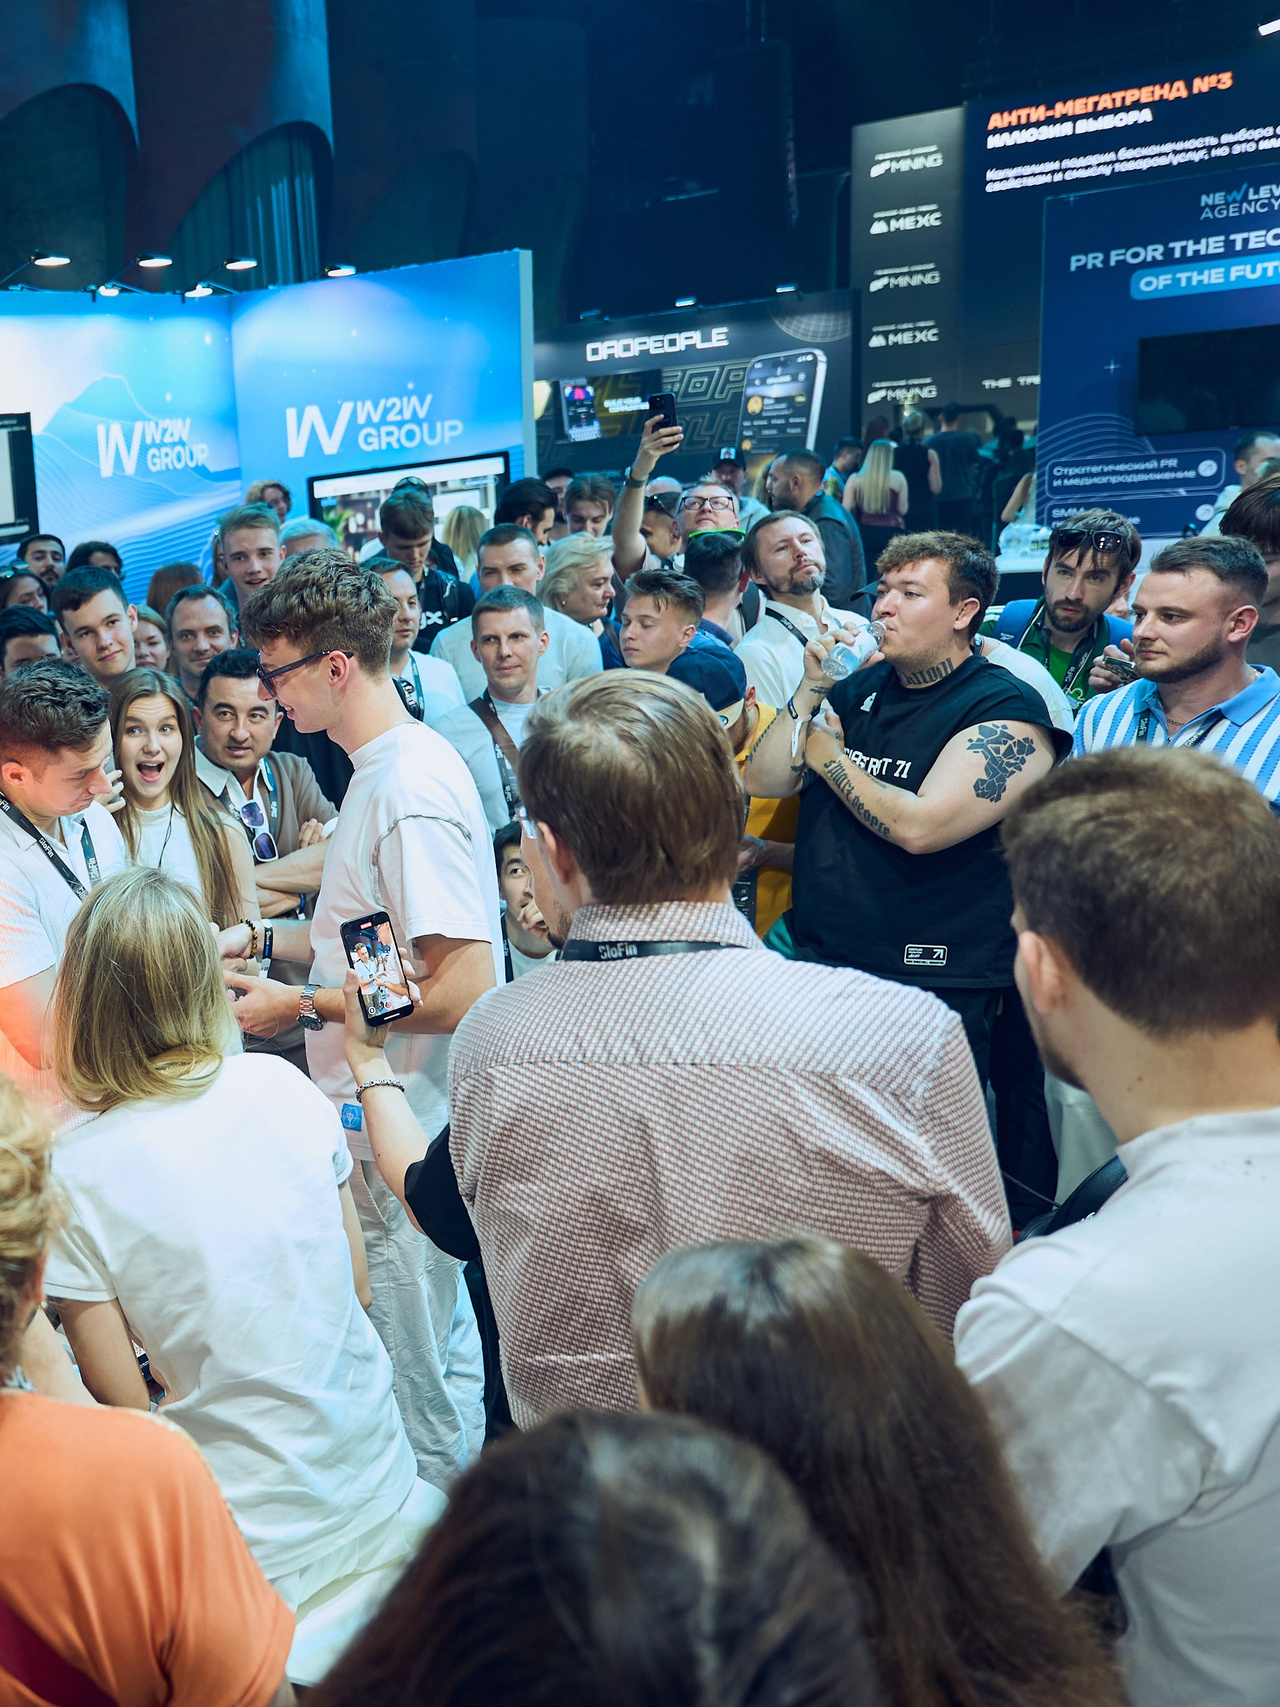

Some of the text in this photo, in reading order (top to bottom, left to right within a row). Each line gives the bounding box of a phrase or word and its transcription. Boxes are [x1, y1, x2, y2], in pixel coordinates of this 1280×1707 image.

[987, 71, 1234, 130] АНТИ-МЕГАТРЕНД №3
[987, 108, 1153, 149] ИЛЛЮЗИЯ ВЫБОРА
[890, 212, 942, 231] MEXC
[1200, 198, 1280, 220] AGENCY
[1070, 252, 1104, 271] PR
[1109, 244, 1163, 267] FOR
[1168, 235, 1224, 259] THE
[1139, 261, 1280, 292] OF THE FUT
[889, 328, 939, 345] MEXC
[982, 377, 1012, 389] THE
[357, 394, 433, 425] W2W
[144, 418, 190, 446] W2W
[358, 419, 463, 452] GROUP
[147, 443, 208, 472] GROUP
[1053, 458, 1178, 476] Стратегический PR
[1053, 479, 1061, 487] и
[894, 760, 912, 778] 71
